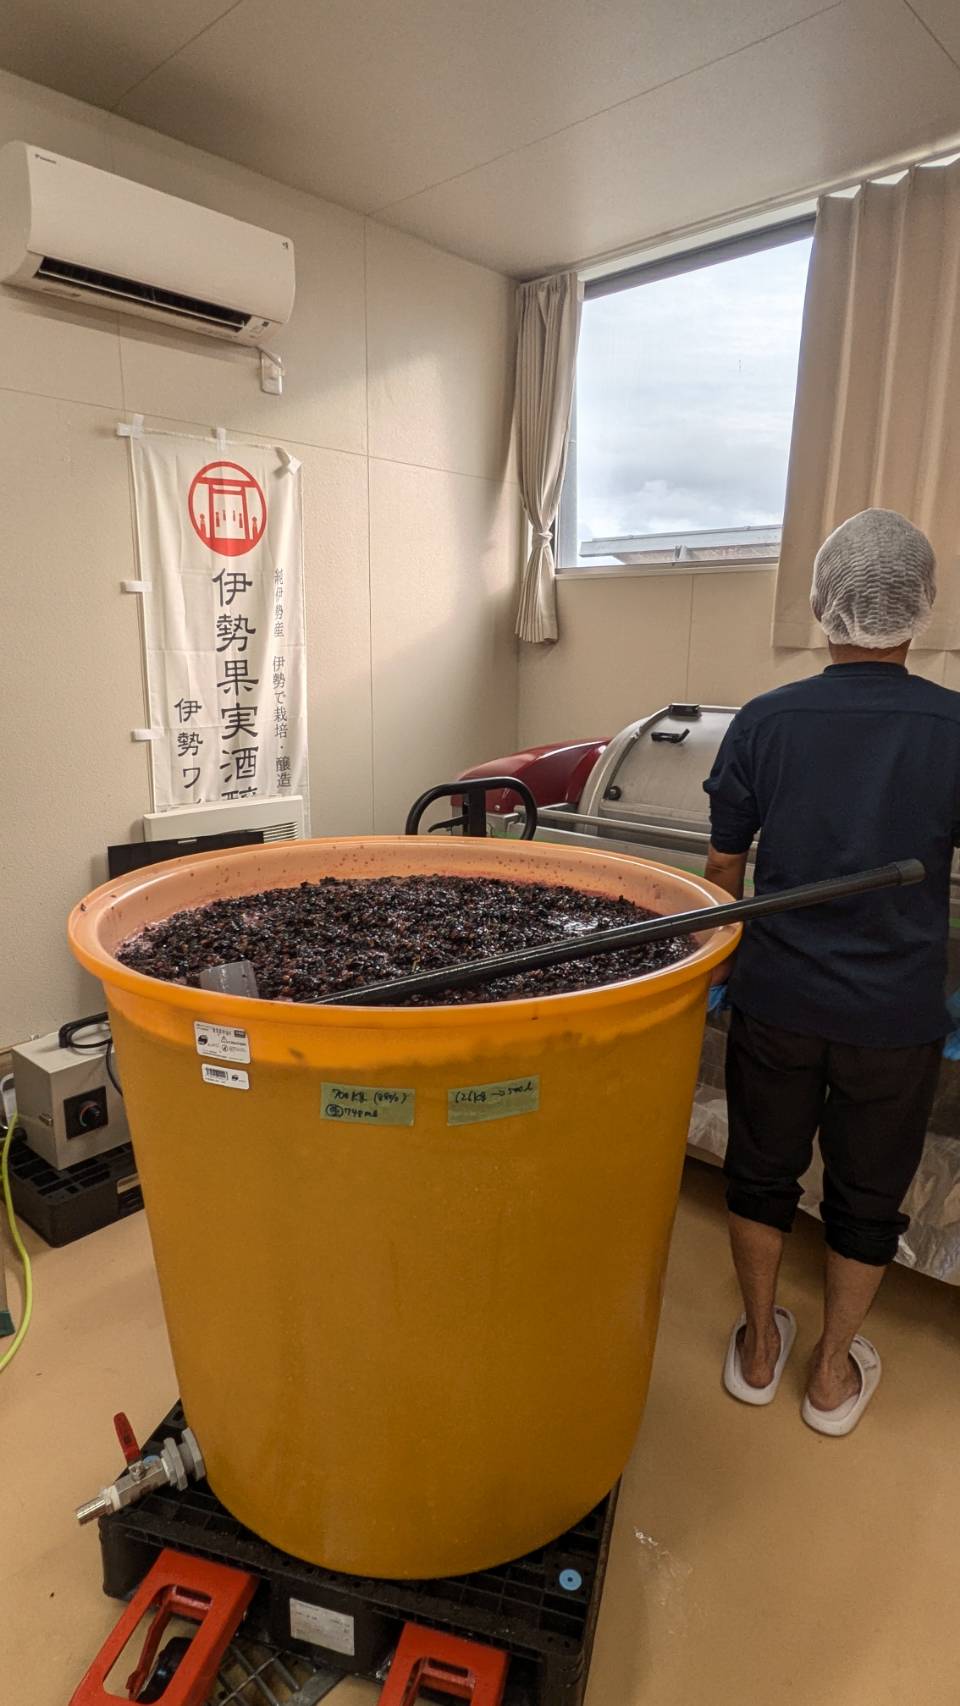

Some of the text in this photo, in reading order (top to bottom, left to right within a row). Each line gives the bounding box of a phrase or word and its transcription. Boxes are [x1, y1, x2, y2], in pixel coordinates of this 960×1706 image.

[212, 568, 260, 800] 伊勢果実酒
[272, 656, 292, 788] 伊勢で栽培・醸造
[174, 698, 204, 803] 伊勢ワ
